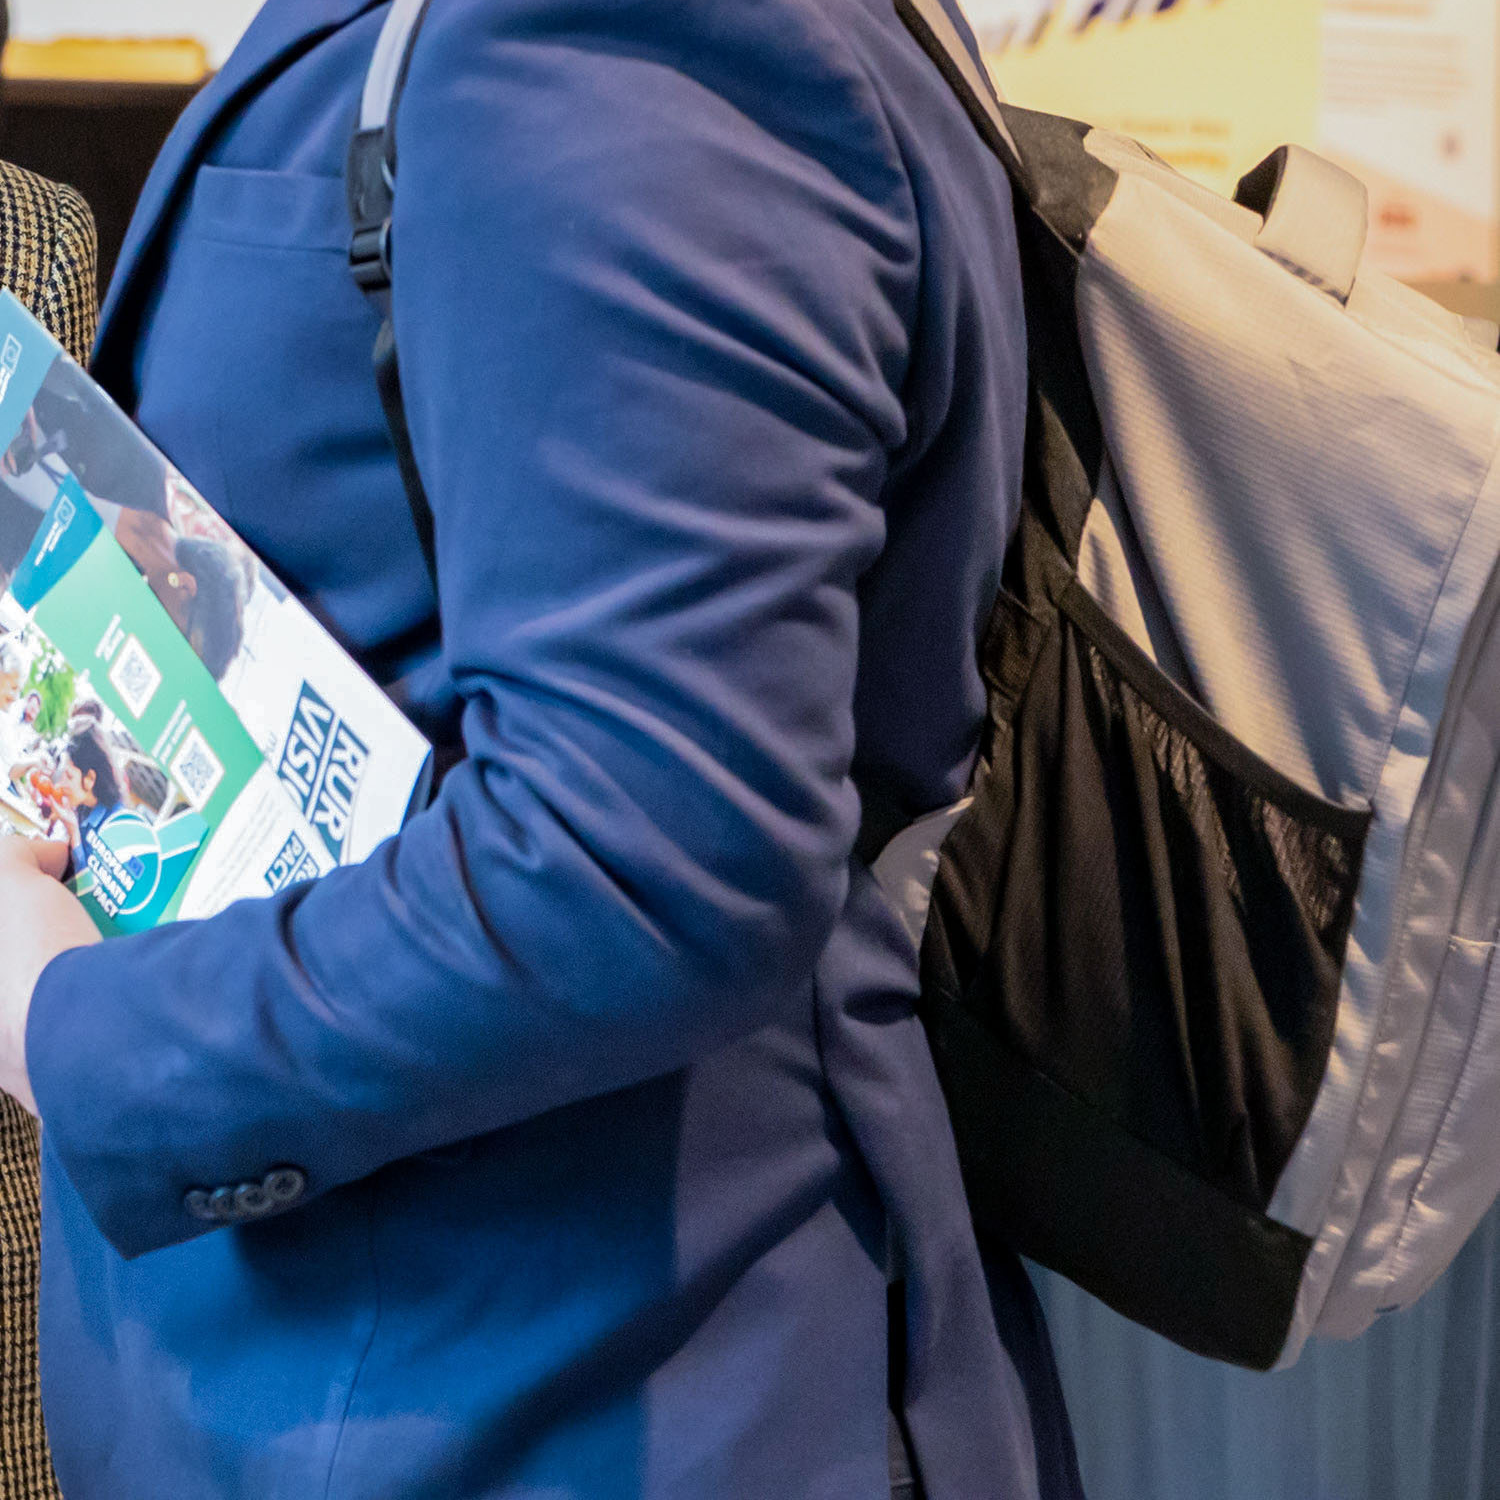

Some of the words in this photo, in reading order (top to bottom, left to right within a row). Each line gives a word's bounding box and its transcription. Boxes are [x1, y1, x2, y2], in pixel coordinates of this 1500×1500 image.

[280, 695, 334, 810] VISI
[314, 728, 368, 841] RUR
[86, 828, 135, 891] EUROPEAN
[87, 854, 127, 905] CLIMATE
[267, 834, 302, 891] PACT
[93, 885, 119, 918] PACT
